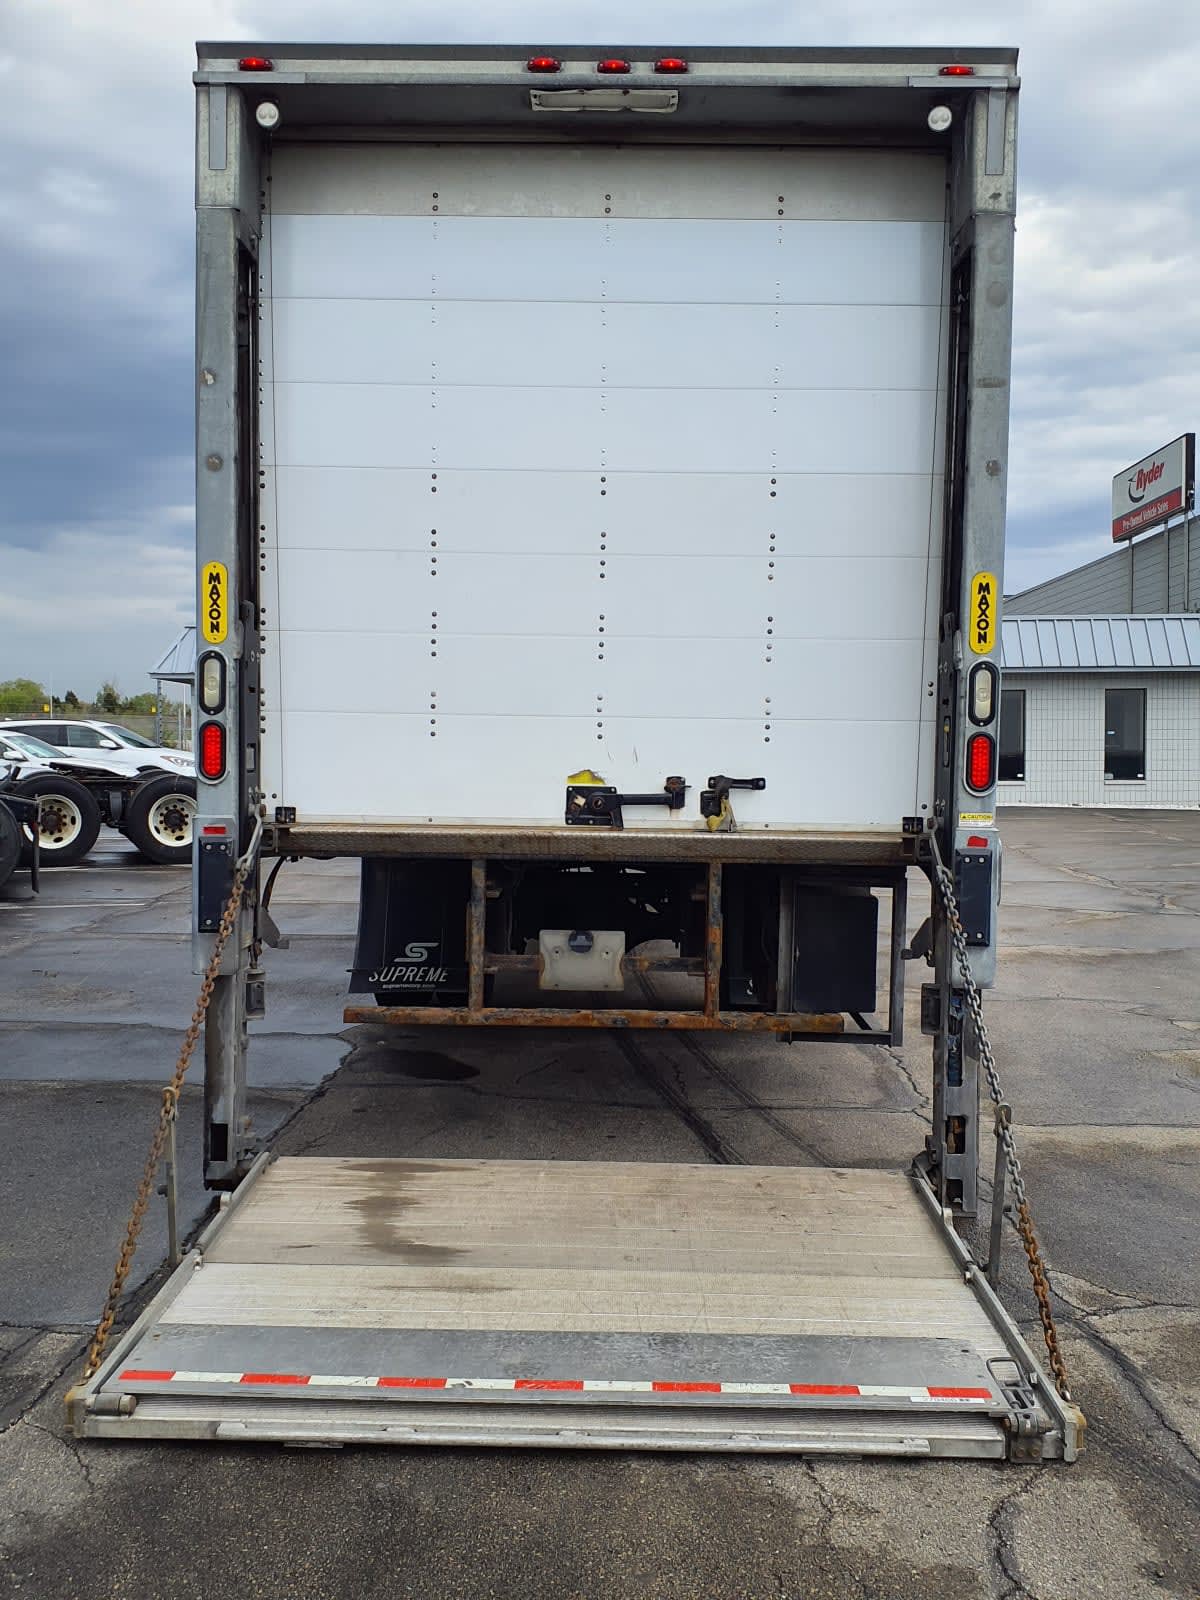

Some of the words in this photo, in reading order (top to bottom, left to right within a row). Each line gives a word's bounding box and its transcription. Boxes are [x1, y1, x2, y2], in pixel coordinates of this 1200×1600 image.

[1136, 461, 1165, 492] Ryder
[208, 571, 222, 634] MAXON
[977, 582, 991, 644] MAXON
